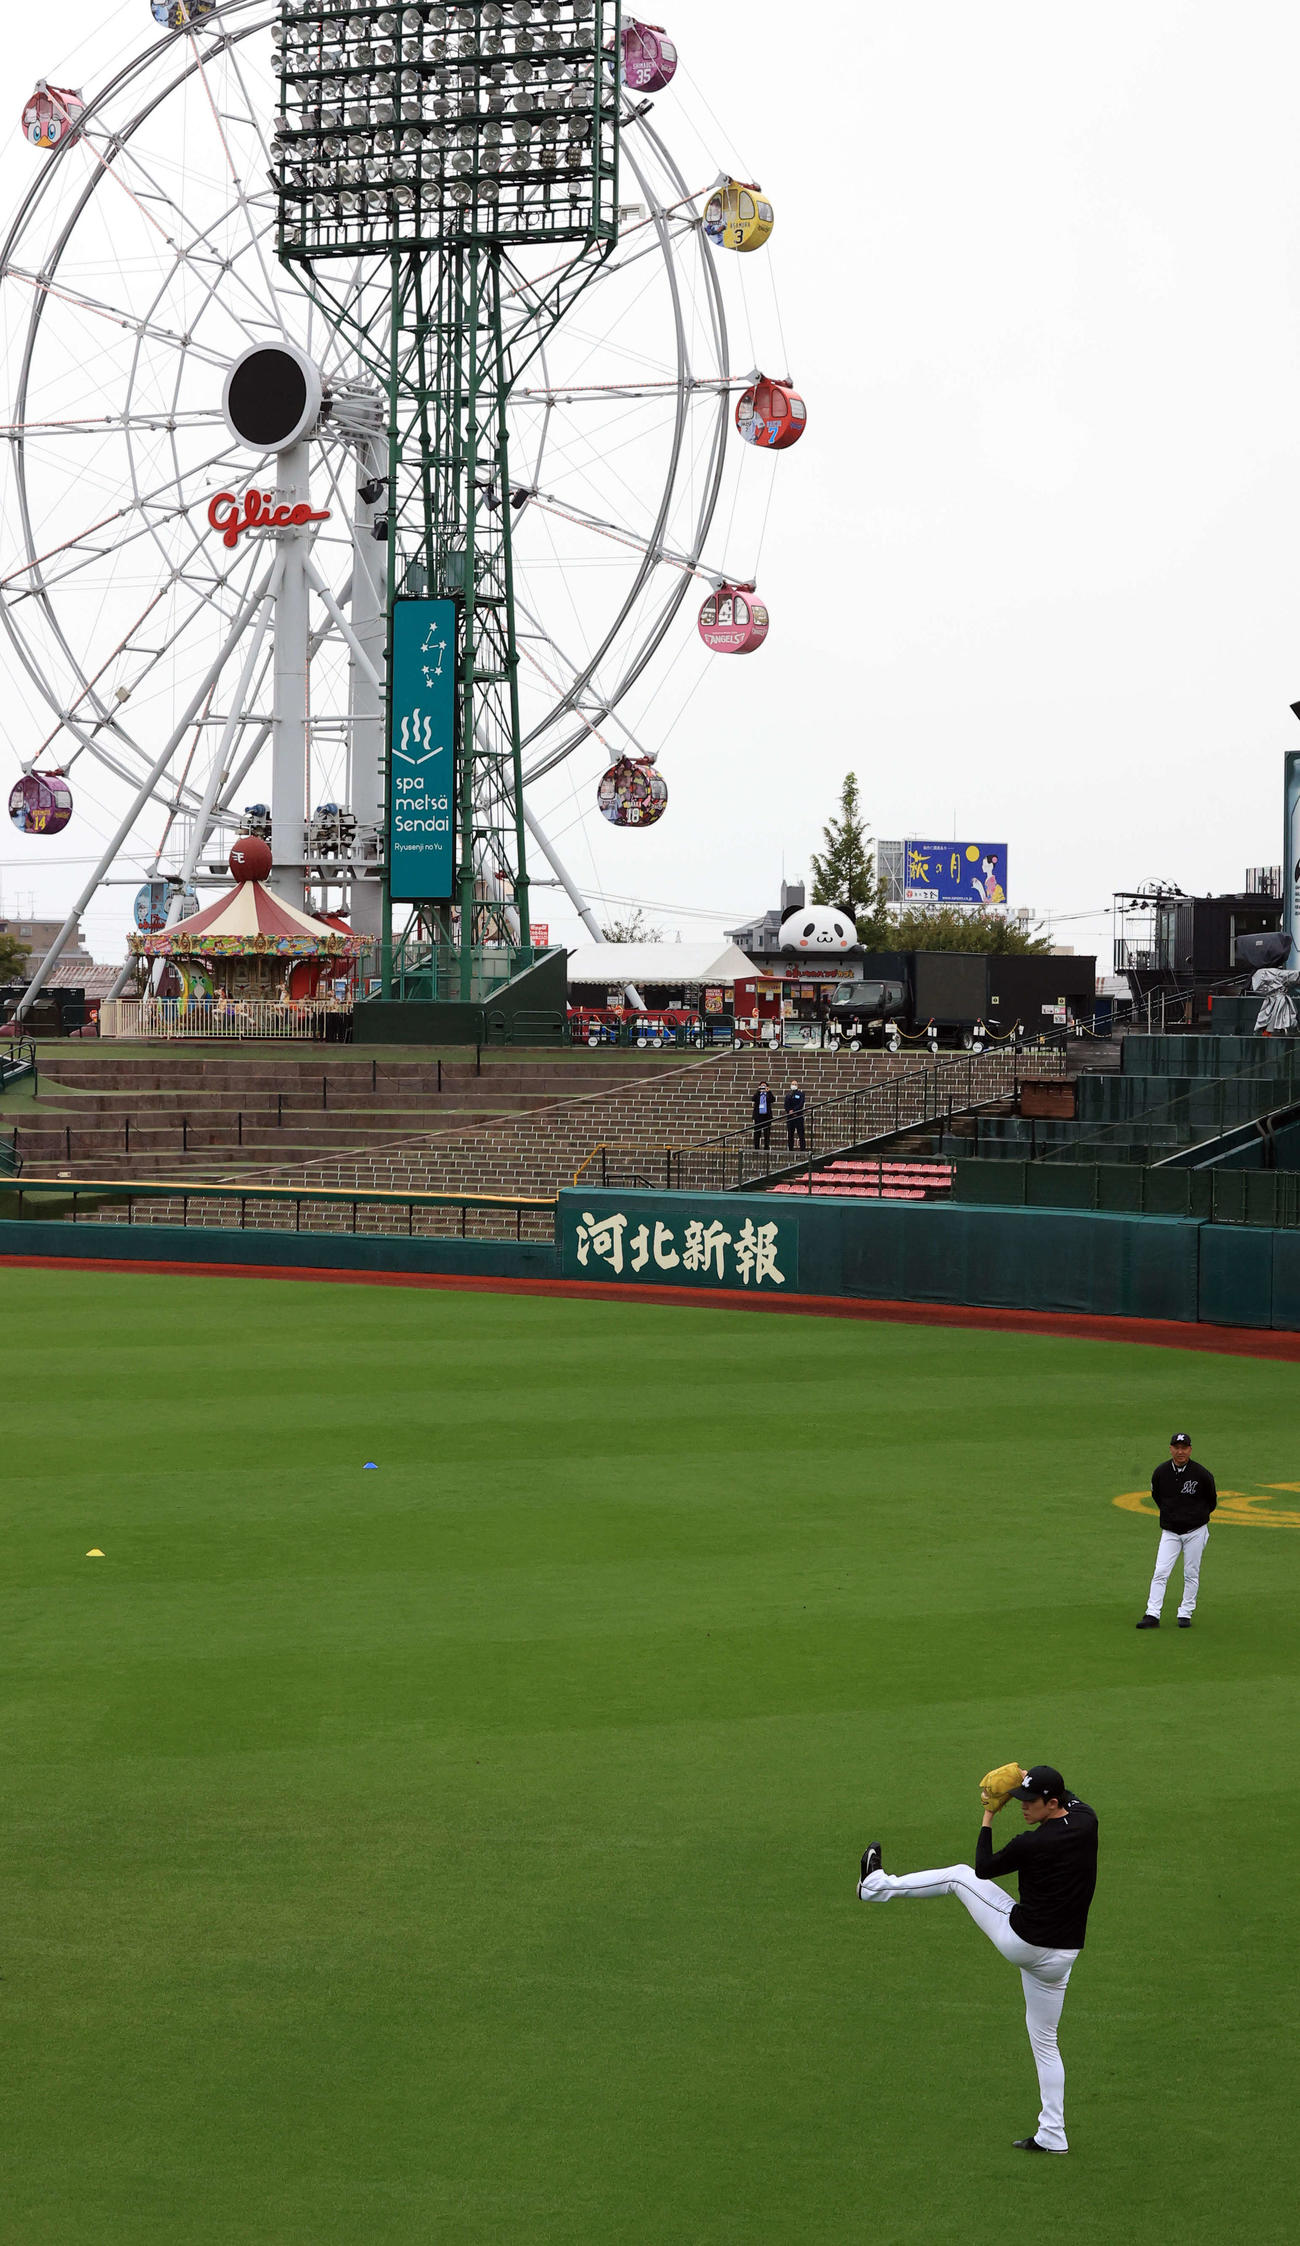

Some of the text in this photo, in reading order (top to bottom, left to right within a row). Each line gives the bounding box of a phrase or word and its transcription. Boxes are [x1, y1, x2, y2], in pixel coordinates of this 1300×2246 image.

[636, 69, 651, 84] 35
[734, 229, 744, 244] 3
[768, 427, 778, 444] 7
[207, 489, 331, 548] Glico
[396, 777, 424, 794] spa
[395, 793, 448, 811] metsä
[34, 815, 46, 831] 14
[394, 815, 449, 832] Sendai
[626, 807, 640, 823] 18
[394, 842, 424, 852] Ryusenji
[575, 1211, 786, 1285] 河北新報
